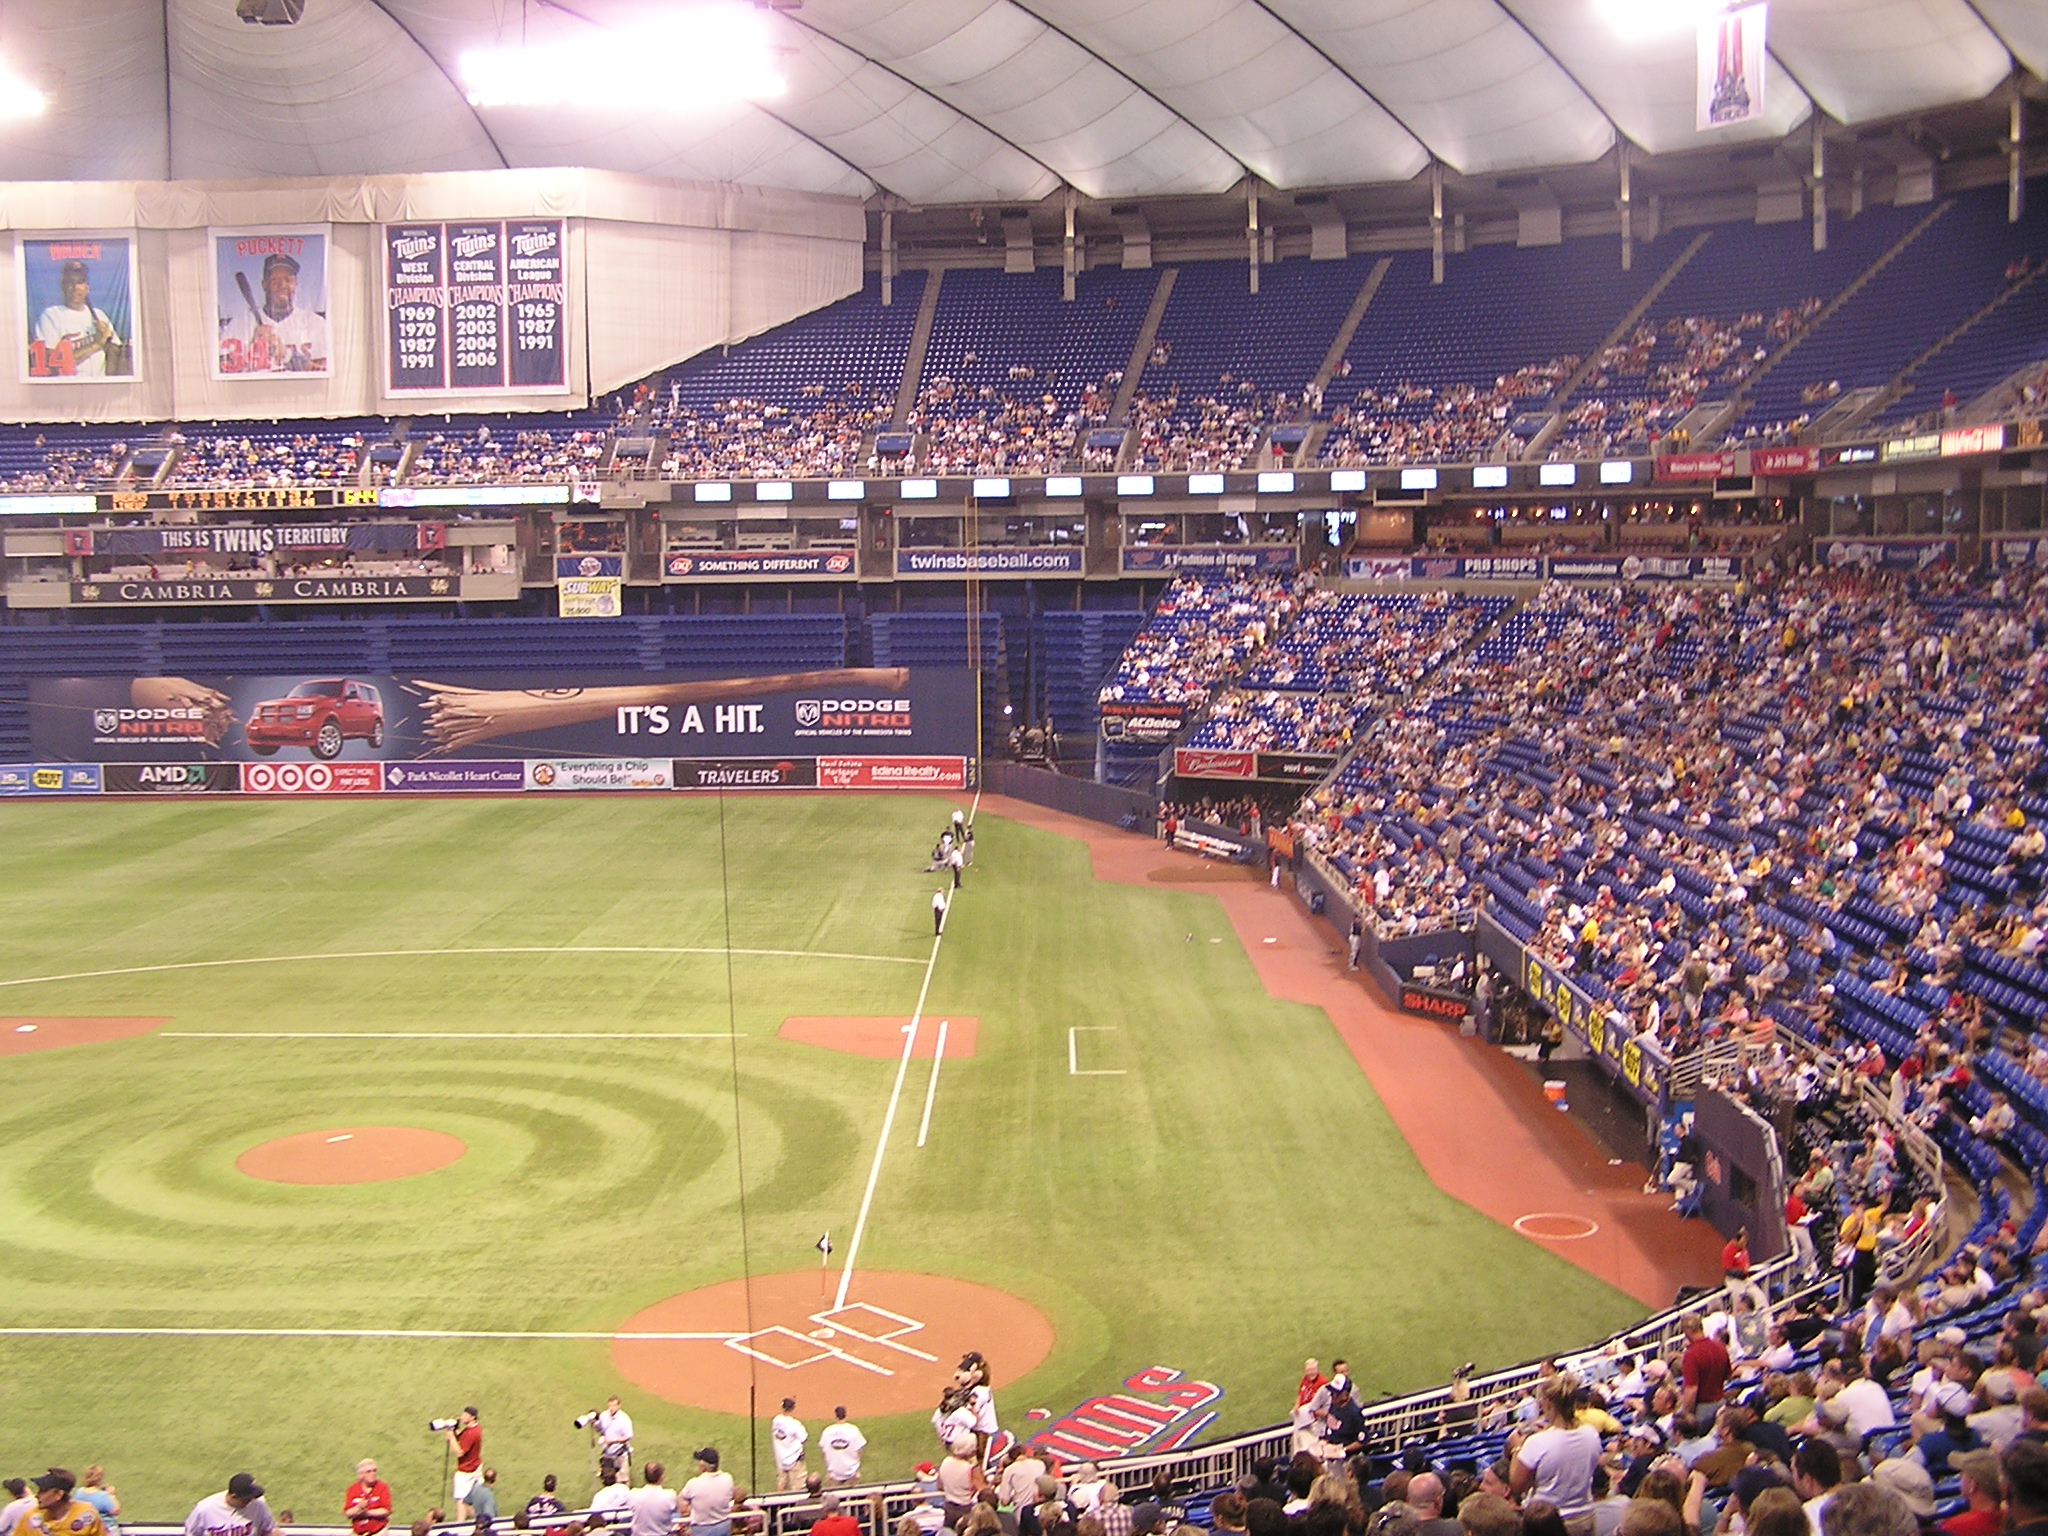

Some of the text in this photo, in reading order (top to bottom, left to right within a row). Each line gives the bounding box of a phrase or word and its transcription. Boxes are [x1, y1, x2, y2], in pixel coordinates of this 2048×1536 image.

[236, 237, 305, 259] PUCKETT
[392, 236, 436, 260] Twins
[451, 233, 496, 258] Twins
[511, 232, 557, 256] Twins
[401, 262, 429, 273] WEST
[453, 260, 495, 271] CENTRAL
[510, 258, 559, 270] AMERICAN
[396, 273, 434, 284] Division
[456, 271, 493, 282] Division
[517, 270, 552, 281] League
[388, 286, 444, 310] CHAMPIONS
[448, 284, 503, 308] CHAMPIONS
[508, 283, 563, 306] CHAMPIONS
[399, 306, 436, 321] 1969
[456, 304, 496, 319] 2002
[517, 303, 555, 318] 1965
[399, 322, 437, 337] 1970
[456, 320, 497, 335] 2003
[517, 319, 555, 334] 1987
[399, 338, 437, 353] 1987
[456, 336, 497, 351] 2004
[519, 335, 553, 350] 1991
[29, 339, 77, 376] 14
[221, 338, 271, 373] 34
[400, 354, 434, 368] 1991
[456, 351, 497, 367] 2006
[161, 527, 348, 552] THIS IS TWINS TERRITORY
[698, 559, 819, 572] SOMETHING DIFFERENT
[910, 553, 1069, 569] twinsbaseball.com
[1164, 554, 1171, 565] A
[1216, 554, 1226, 565] of
[1464, 558, 1491, 572] PRO
[1493, 558, 1537, 572] SHOPS
[120, 584, 233, 600] CAMBRIA
[294, 580, 408, 597] CAMBRIA
[563, 580, 618, 595] SUBWAY
[822, 700, 911, 711] DODGE
[119, 708, 203, 719] DODGE
[617, 704, 765, 734] IT'S A HIT.
[822, 713, 911, 726] NITRO
[119, 721, 203, 734] NITRO
[1127, 717, 1181, 729] ACDelco
[625, 761, 649, 772] Chip
[871, 766, 902, 777] Edina
[1187, 758, 1242, 771] Budweiser
[140, 767, 187, 783] AMD
[407, 770, 521, 781] Park Nicollet Heart Center
[572, 774, 607, 784] Should
[698, 770, 780, 784] TRAVELERS
[1403, 991, 1467, 1018] SHARP
